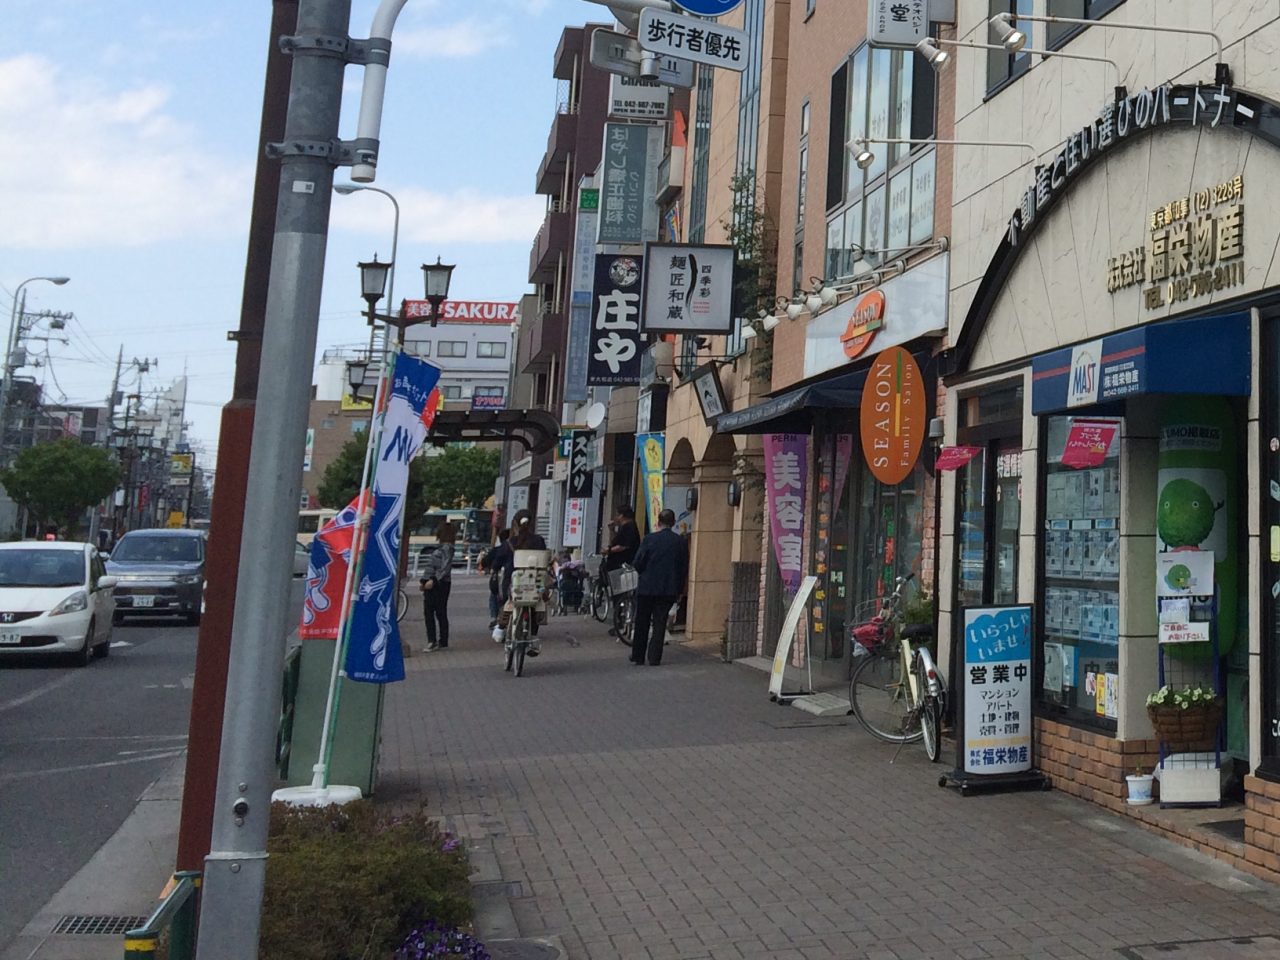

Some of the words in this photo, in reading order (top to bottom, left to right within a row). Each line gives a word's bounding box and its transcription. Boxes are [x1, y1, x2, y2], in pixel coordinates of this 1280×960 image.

[647, 17, 742, 62] 歩行者優先
[666, 254, 688, 321] 麺匠和蔵
[407, 302, 441, 318] 美容
[593, 289, 640, 374] 庄や
[903, 362, 913, 406] Salon
[1072, 362, 1096, 397] MAST
[874, 362, 892, 469] SEASON
[901, 415, 910, 467] Family
[771, 451, 803, 572] 美容室
[969, 662, 1028, 685] 営業中
[980, 687, 1020, 701] マンション
[986, 700, 1013, 712] アパート
[982, 746, 1029, 766] 福栄物産
